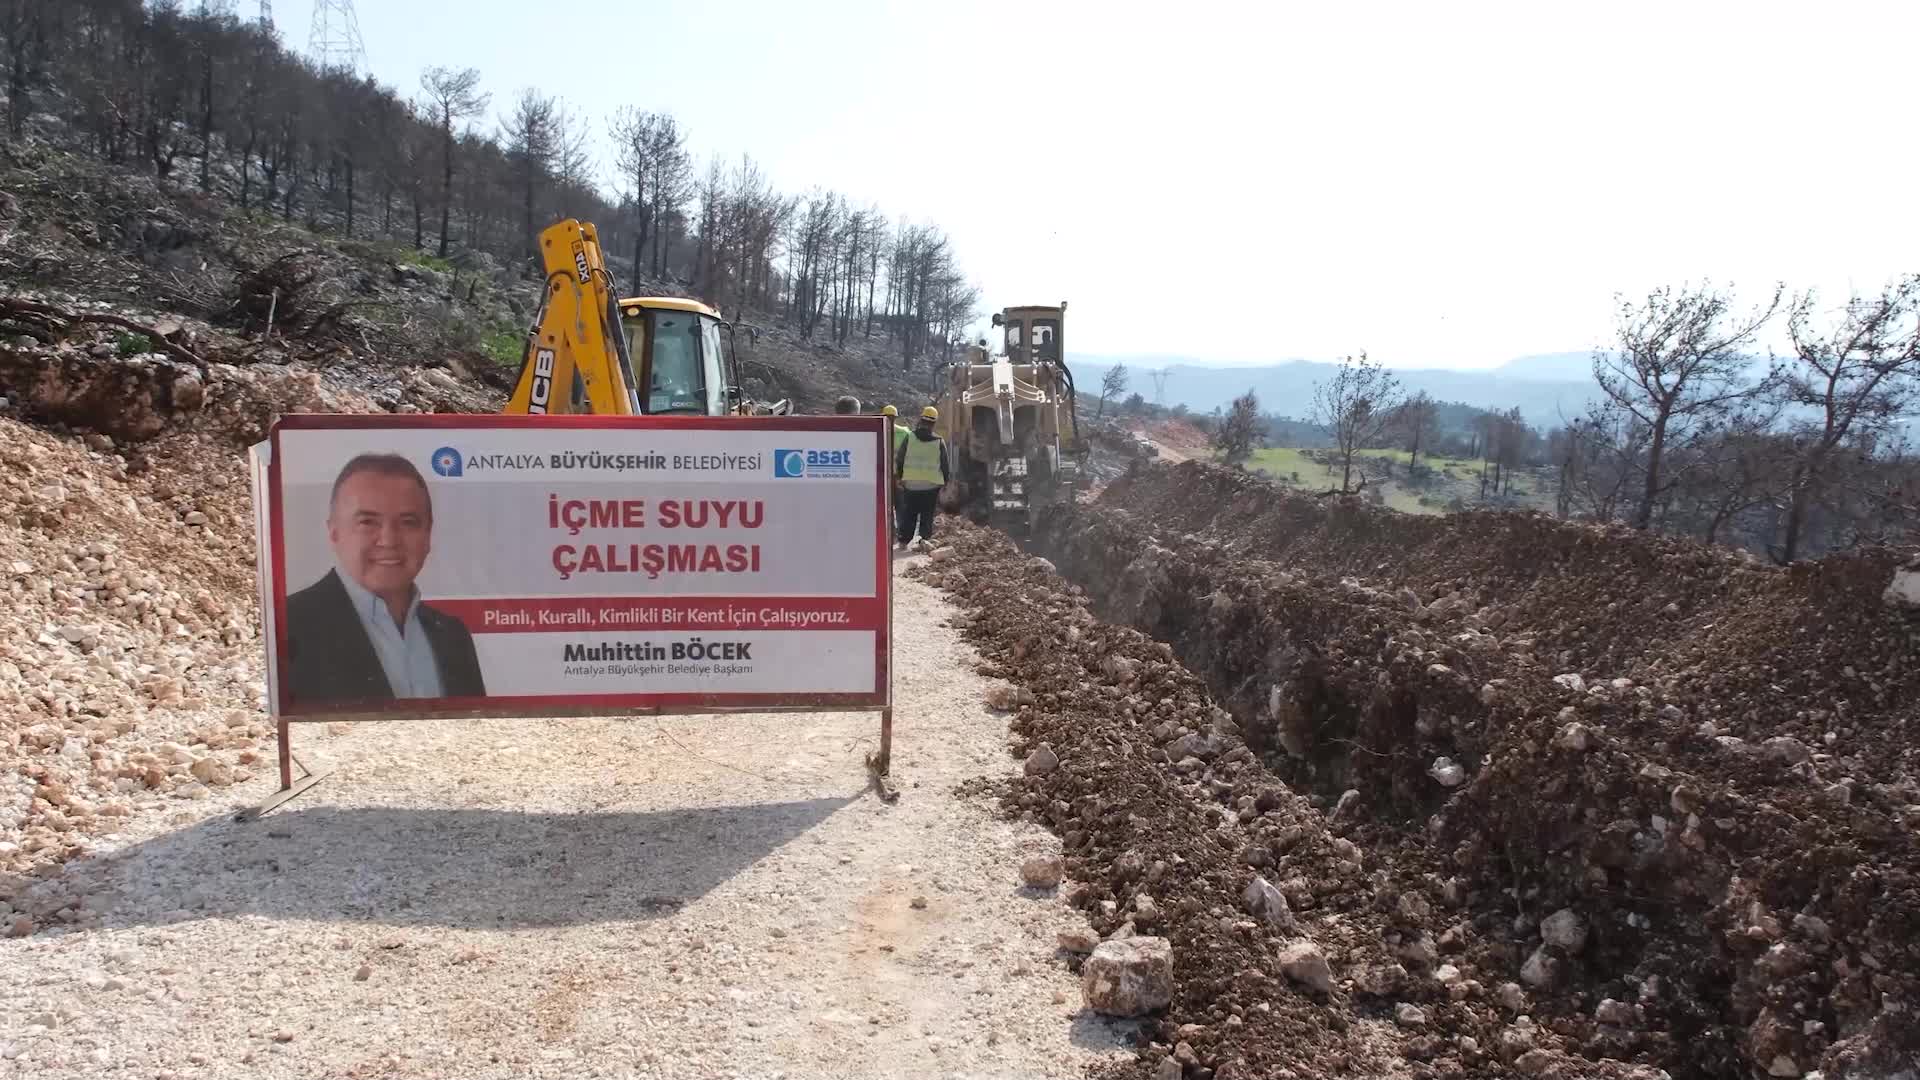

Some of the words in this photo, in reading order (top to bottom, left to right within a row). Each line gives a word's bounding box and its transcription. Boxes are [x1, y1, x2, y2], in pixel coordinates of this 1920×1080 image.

[467, 454, 545, 470] ANTALYA
[550, 450, 667, 473] BÜYÜKŞEHİR
[673, 451, 762, 470] BELEDİYESİ
[806, 450, 851, 465] asat
[549, 493, 645, 536] İÇME
[657, 500, 764, 529] SUYU
[552, 544, 760, 580] ÇALIŞMASI
[484, 609, 535, 627] Planlı,
[539, 608, 596, 626] Kurallı,
[600, 607, 658, 624] Kimlikli
[661, 608, 685, 623] Bir
[687, 608, 725, 623] Kent
[728, 604, 756, 626] İçin
[759, 607, 850, 627] Çalışıyoruz.
[563, 641, 666, 662] Muhittin
[671, 637, 752, 661] BÖCEK
[564, 664, 605, 678] Antalya
[607, 663, 665, 677] Büyükşehir
[667, 663, 711, 677] Belediye
[713, 663, 753, 676] Başkanı
